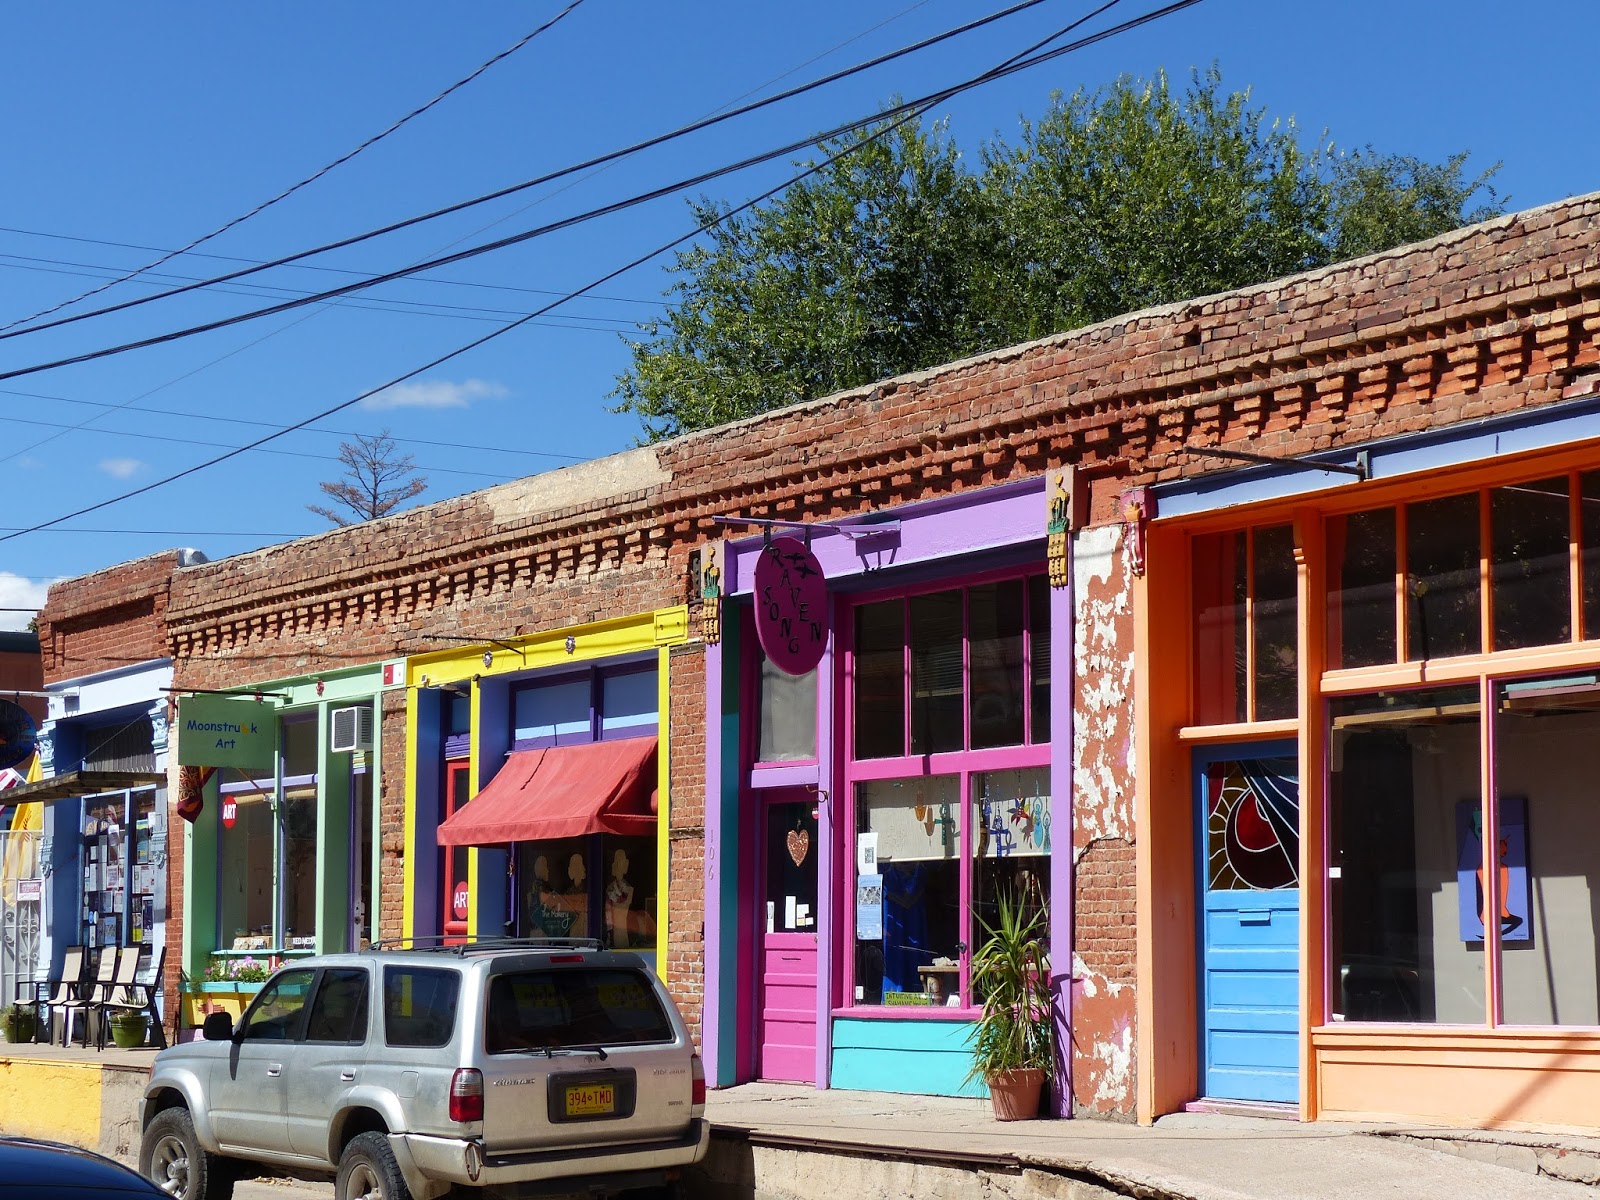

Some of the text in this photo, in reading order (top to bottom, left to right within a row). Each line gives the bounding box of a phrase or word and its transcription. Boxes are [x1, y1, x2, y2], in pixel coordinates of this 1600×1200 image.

[770, 547, 822, 641] RAVEN
[763, 585, 799, 654] SONG
[215, 738, 236, 749] Art
[222, 803, 237, 820] ART
[568, 1091, 587, 1106] 394
